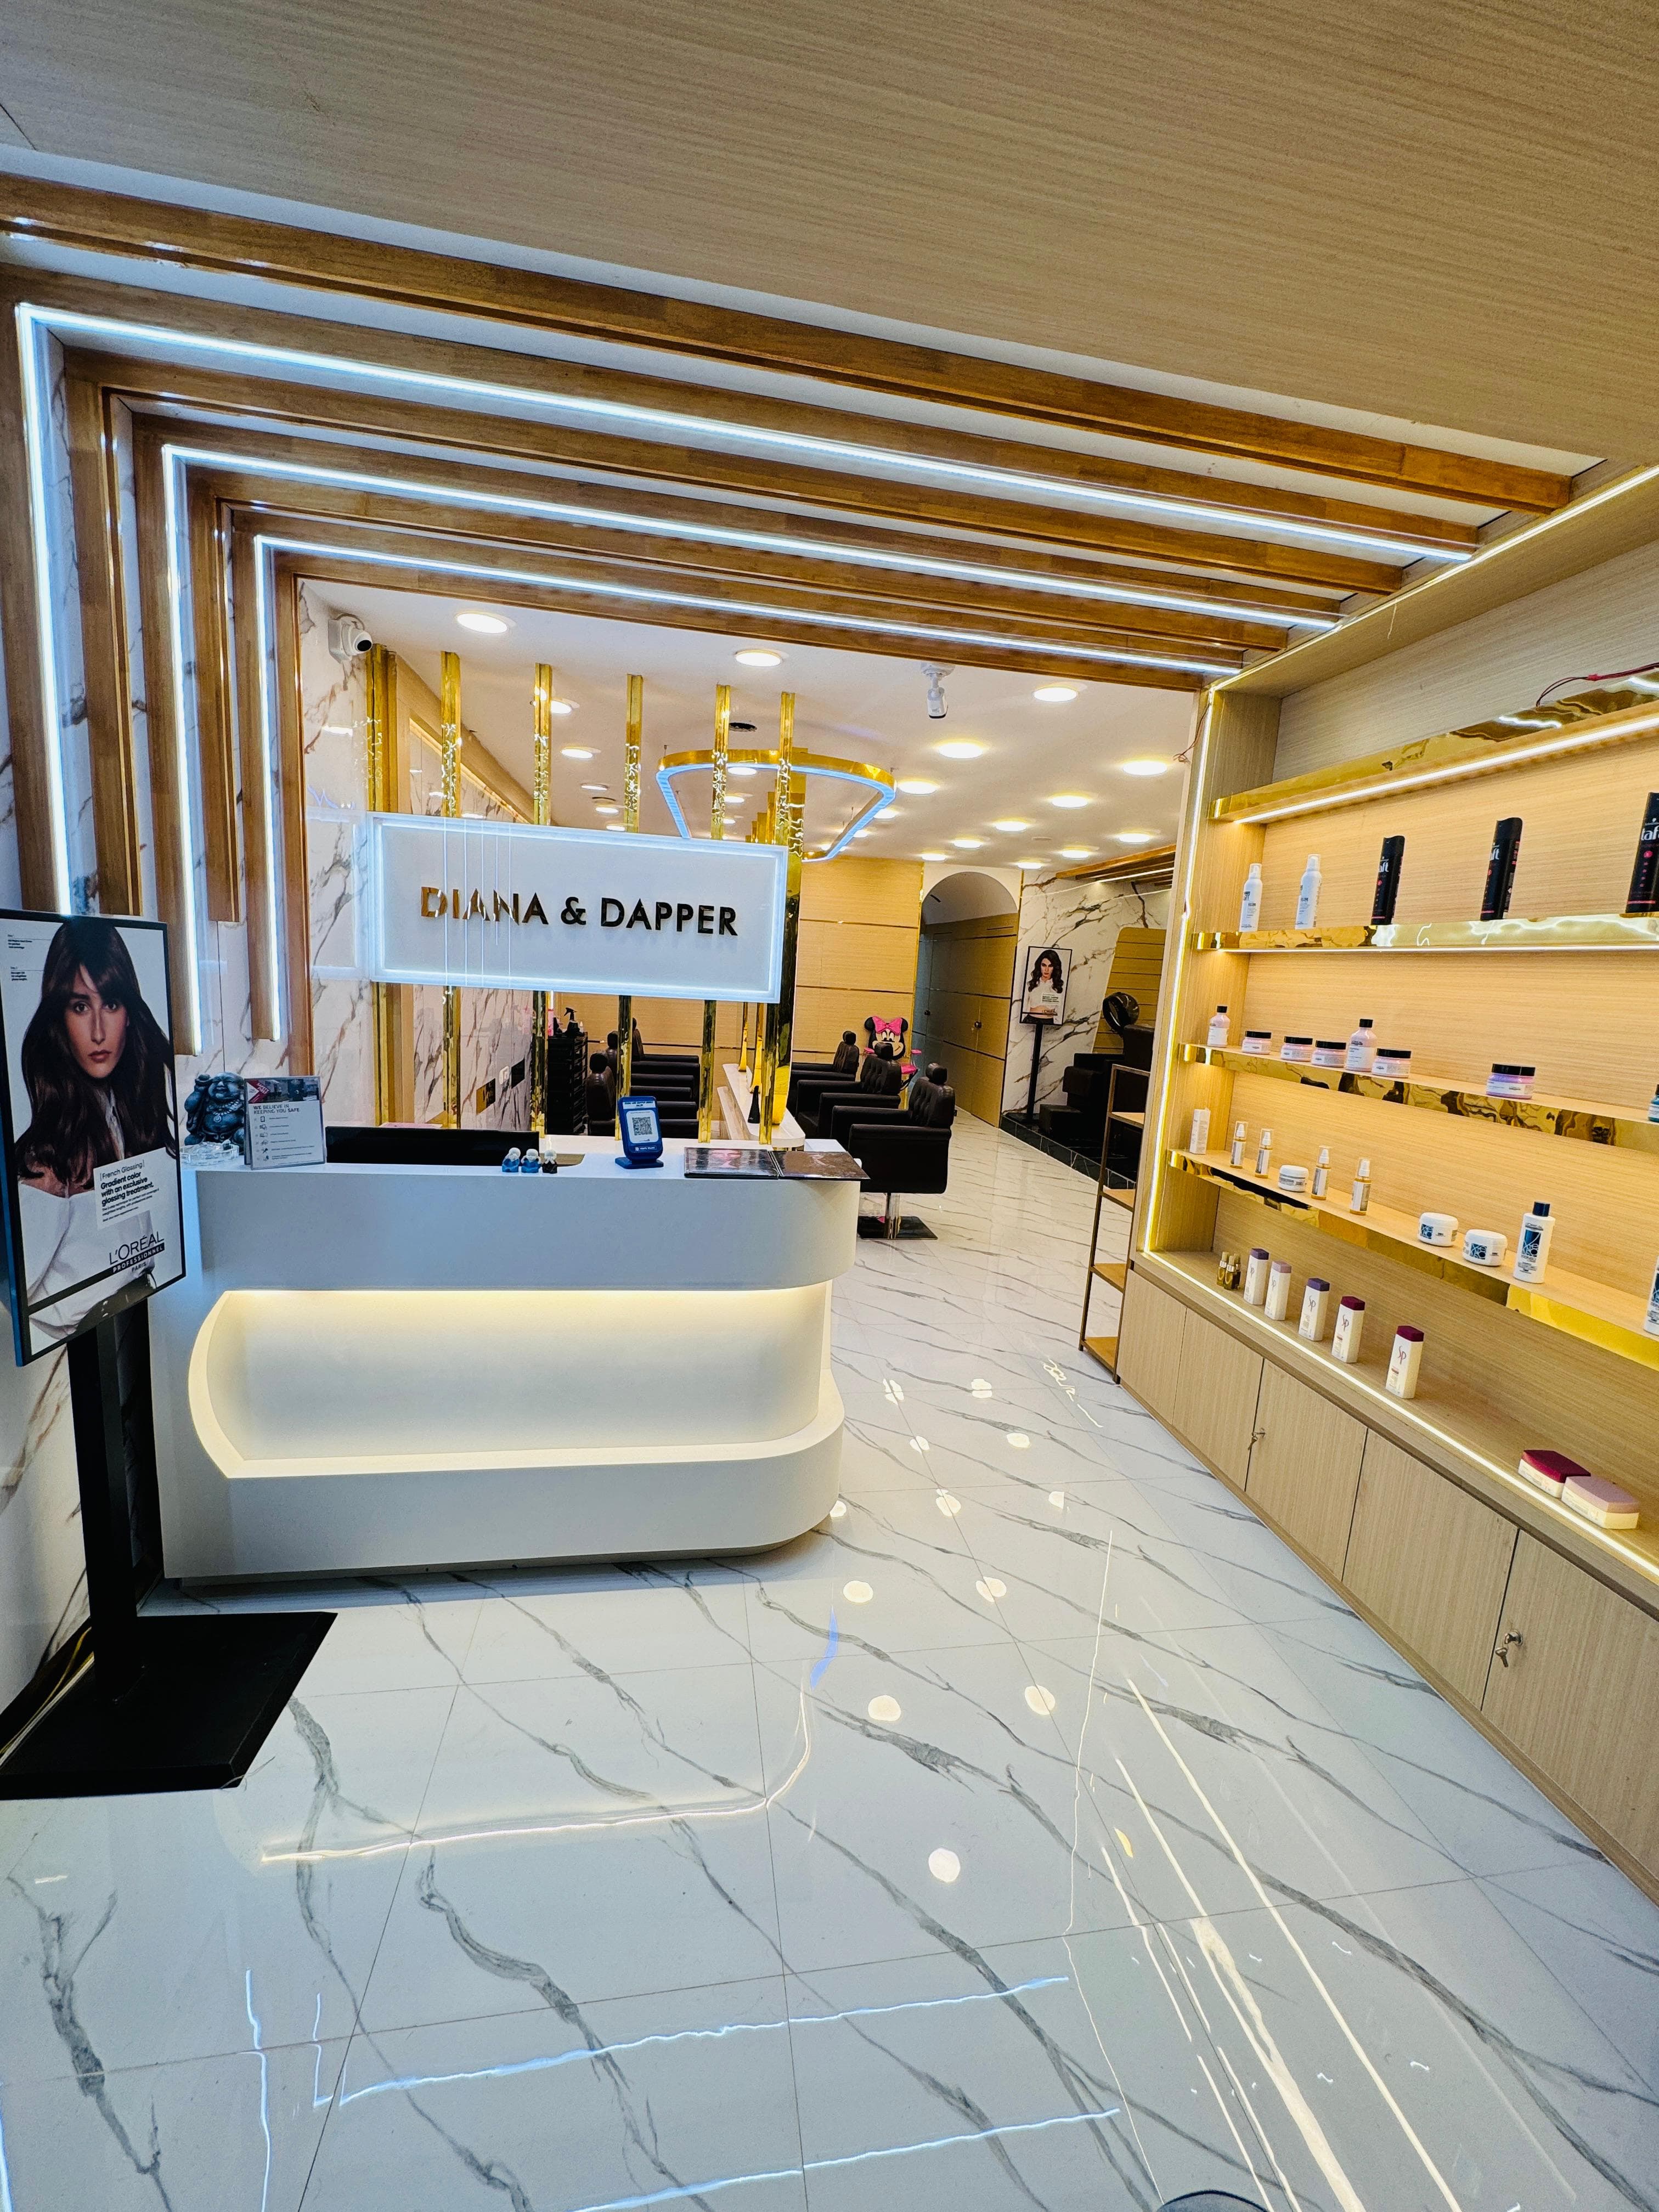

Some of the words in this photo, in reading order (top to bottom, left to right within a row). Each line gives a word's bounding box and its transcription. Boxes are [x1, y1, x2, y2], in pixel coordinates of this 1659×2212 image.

[1641, 826, 1659, 841] taf
[421, 887, 549, 926] DIANA
[560, 896, 586, 926] &
[601, 897, 738, 936] DAPPER
[100, 1176, 126, 1189] Gradient
[127, 1172, 142, 1181] color
[101, 1188, 114, 1197] with
[123, 1177, 148, 1190] exclusive
[102, 1193, 126, 1207] glossing
[109, 1231, 165, 1265] L'ORÉAL
[112, 1245, 163, 1273] PROFESSIONNEL
[132, 1261, 146, 1272] PARIS
